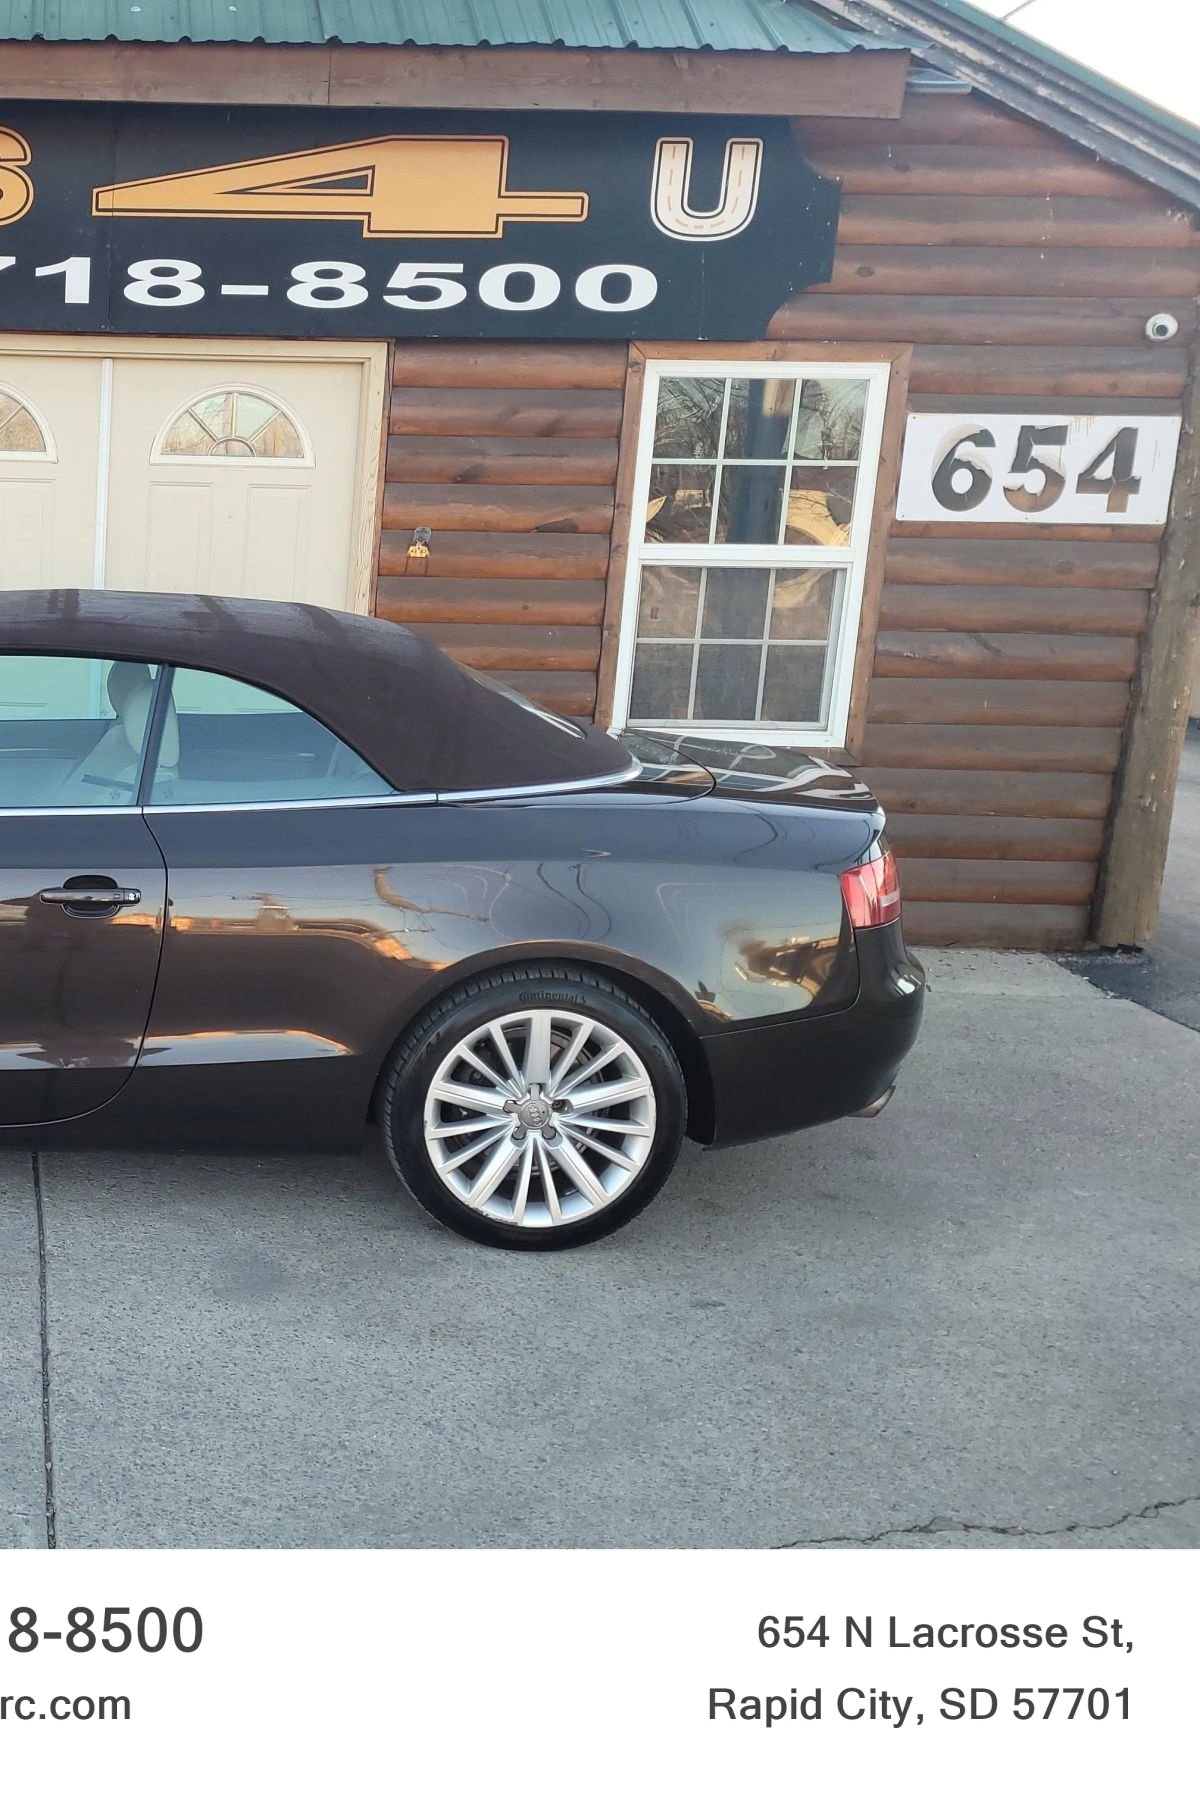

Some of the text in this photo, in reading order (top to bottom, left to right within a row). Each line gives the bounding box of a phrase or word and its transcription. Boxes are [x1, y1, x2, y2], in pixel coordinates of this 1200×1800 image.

[91, 134, 590, 239] 4
[649, 136, 764, 242] U
[930, 422, 1143, 514] 654
